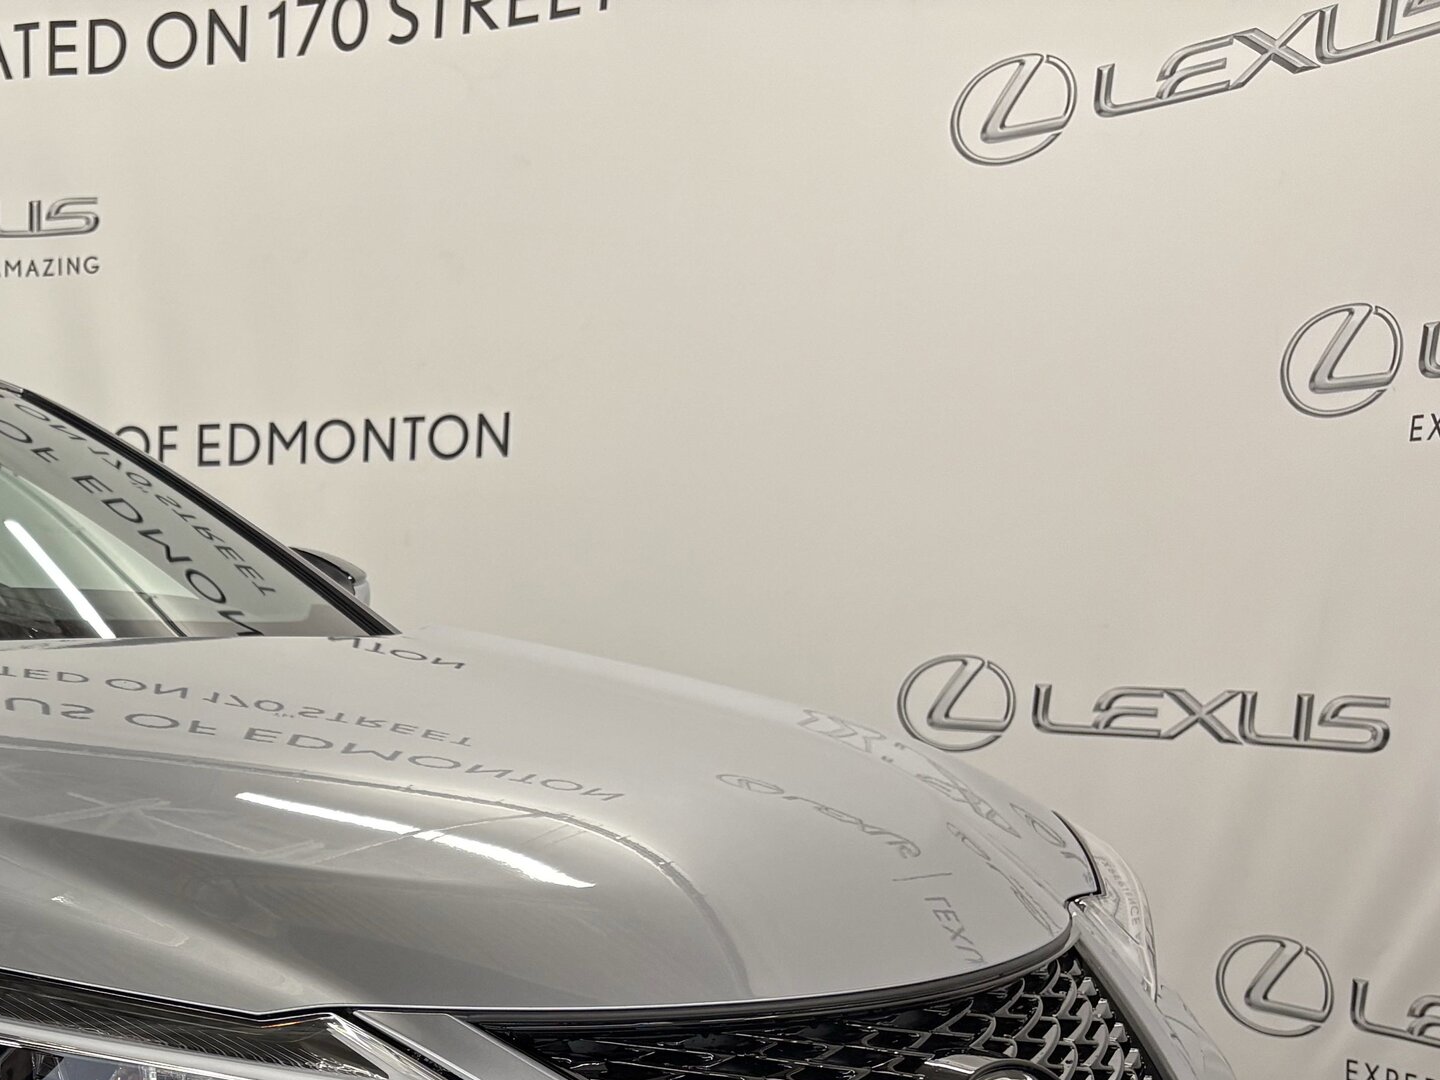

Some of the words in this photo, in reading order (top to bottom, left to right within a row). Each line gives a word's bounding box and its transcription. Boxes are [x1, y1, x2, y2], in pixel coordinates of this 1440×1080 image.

[147, 5, 249, 69] ON
[267, 0, 369, 58] 170
[388, 0, 609, 45] STR
[198, 411, 511, 468] EDMONTON
[1031, 683, 1392, 754] LEXUS
